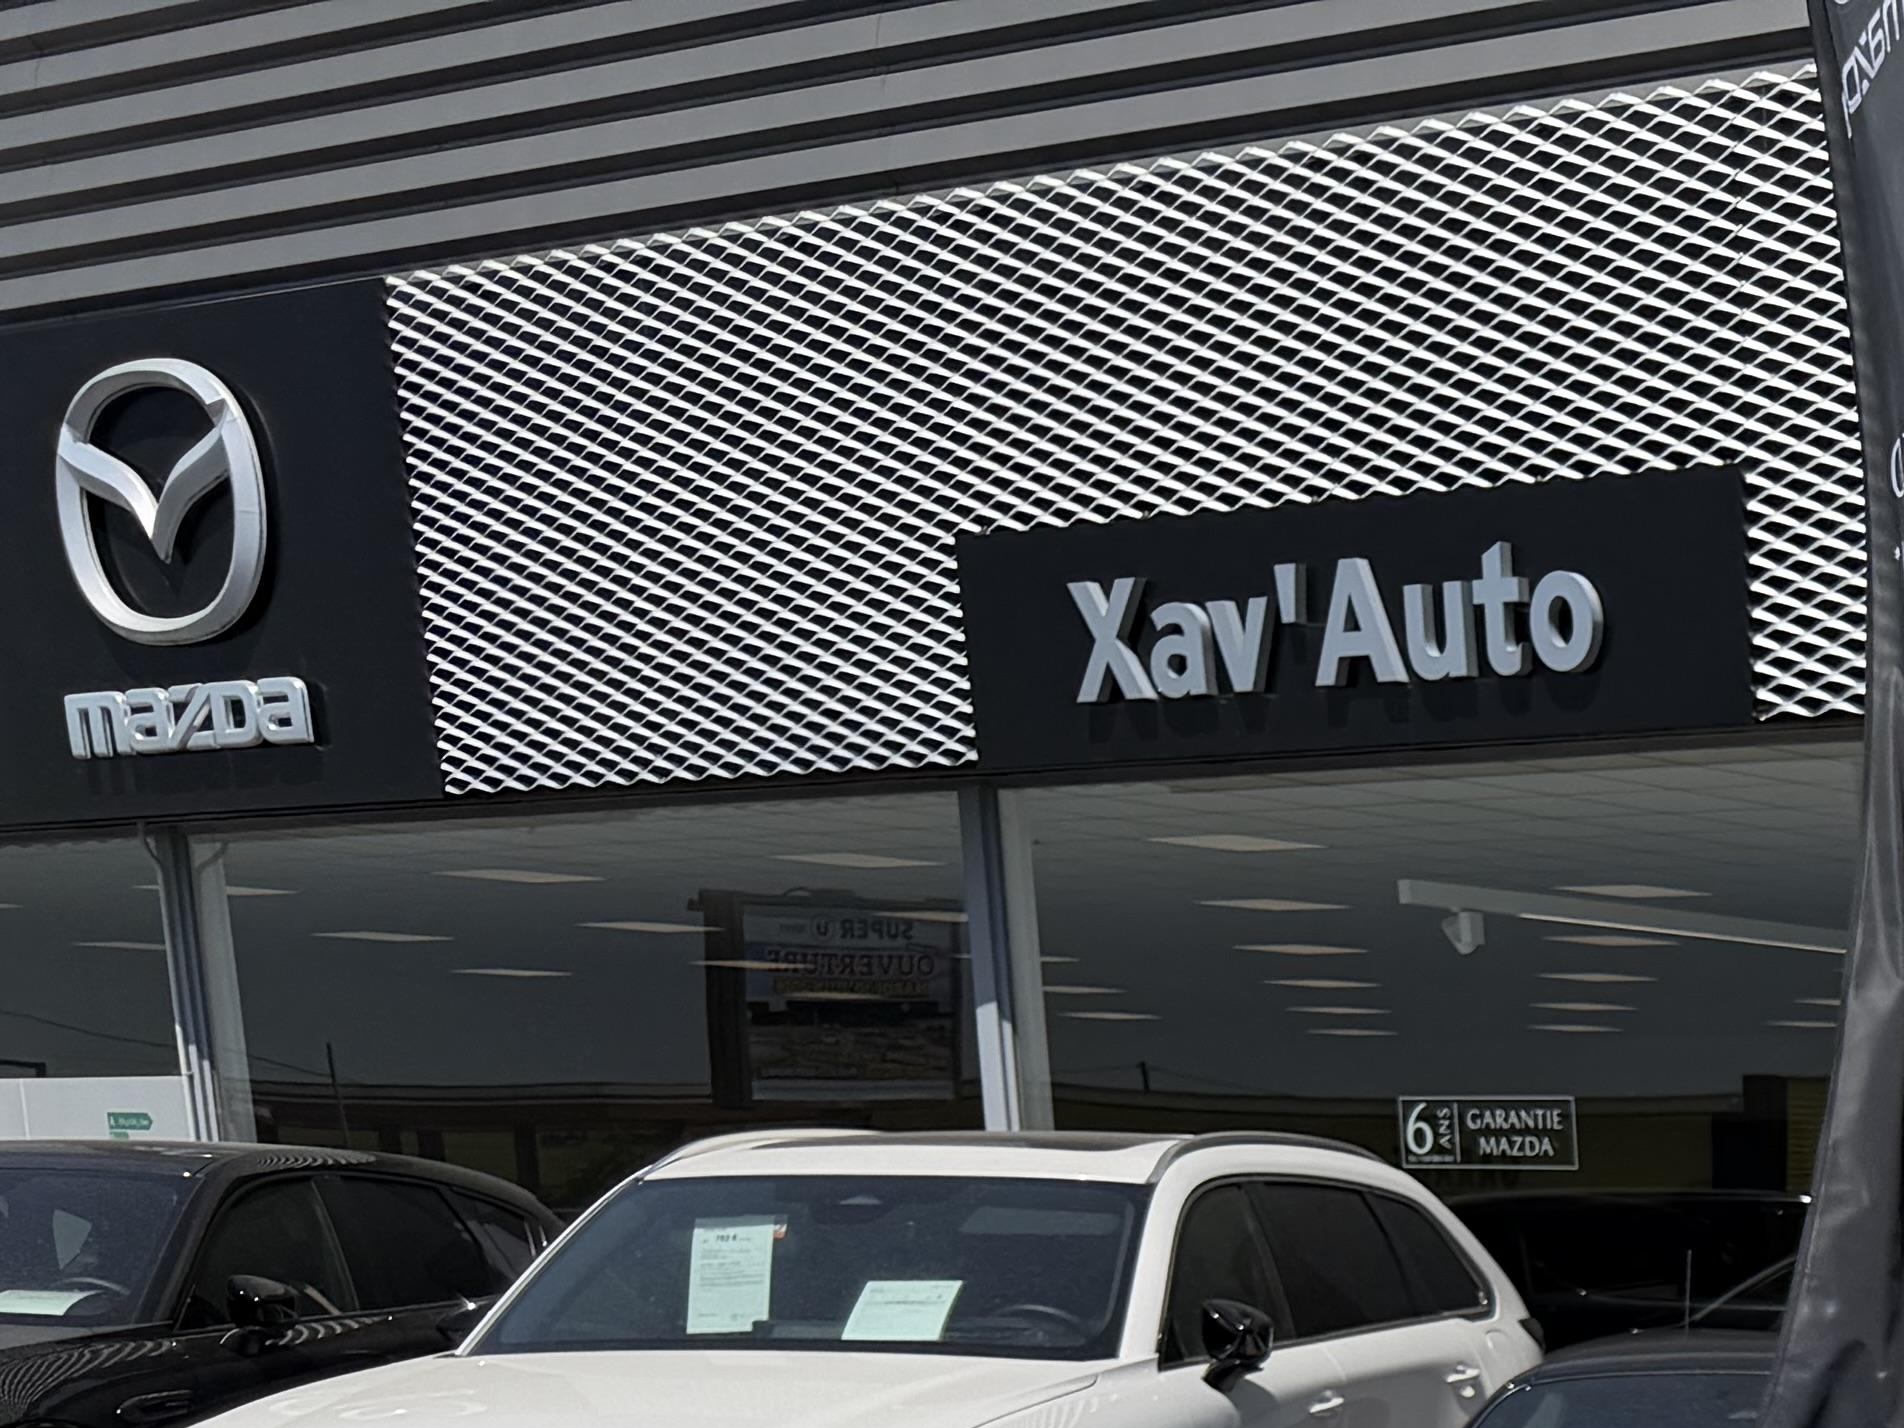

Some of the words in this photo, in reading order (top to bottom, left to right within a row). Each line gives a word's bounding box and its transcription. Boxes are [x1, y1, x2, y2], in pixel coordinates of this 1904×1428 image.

[1067, 540, 1604, 705] Xav'Auto
[1406, 1102, 1435, 1156] 6
[1436, 1107, 1453, 1151] ANS
[1466, 1108, 1564, 1131] GARANTIE
[1479, 1135, 1555, 1158] MAZDA
